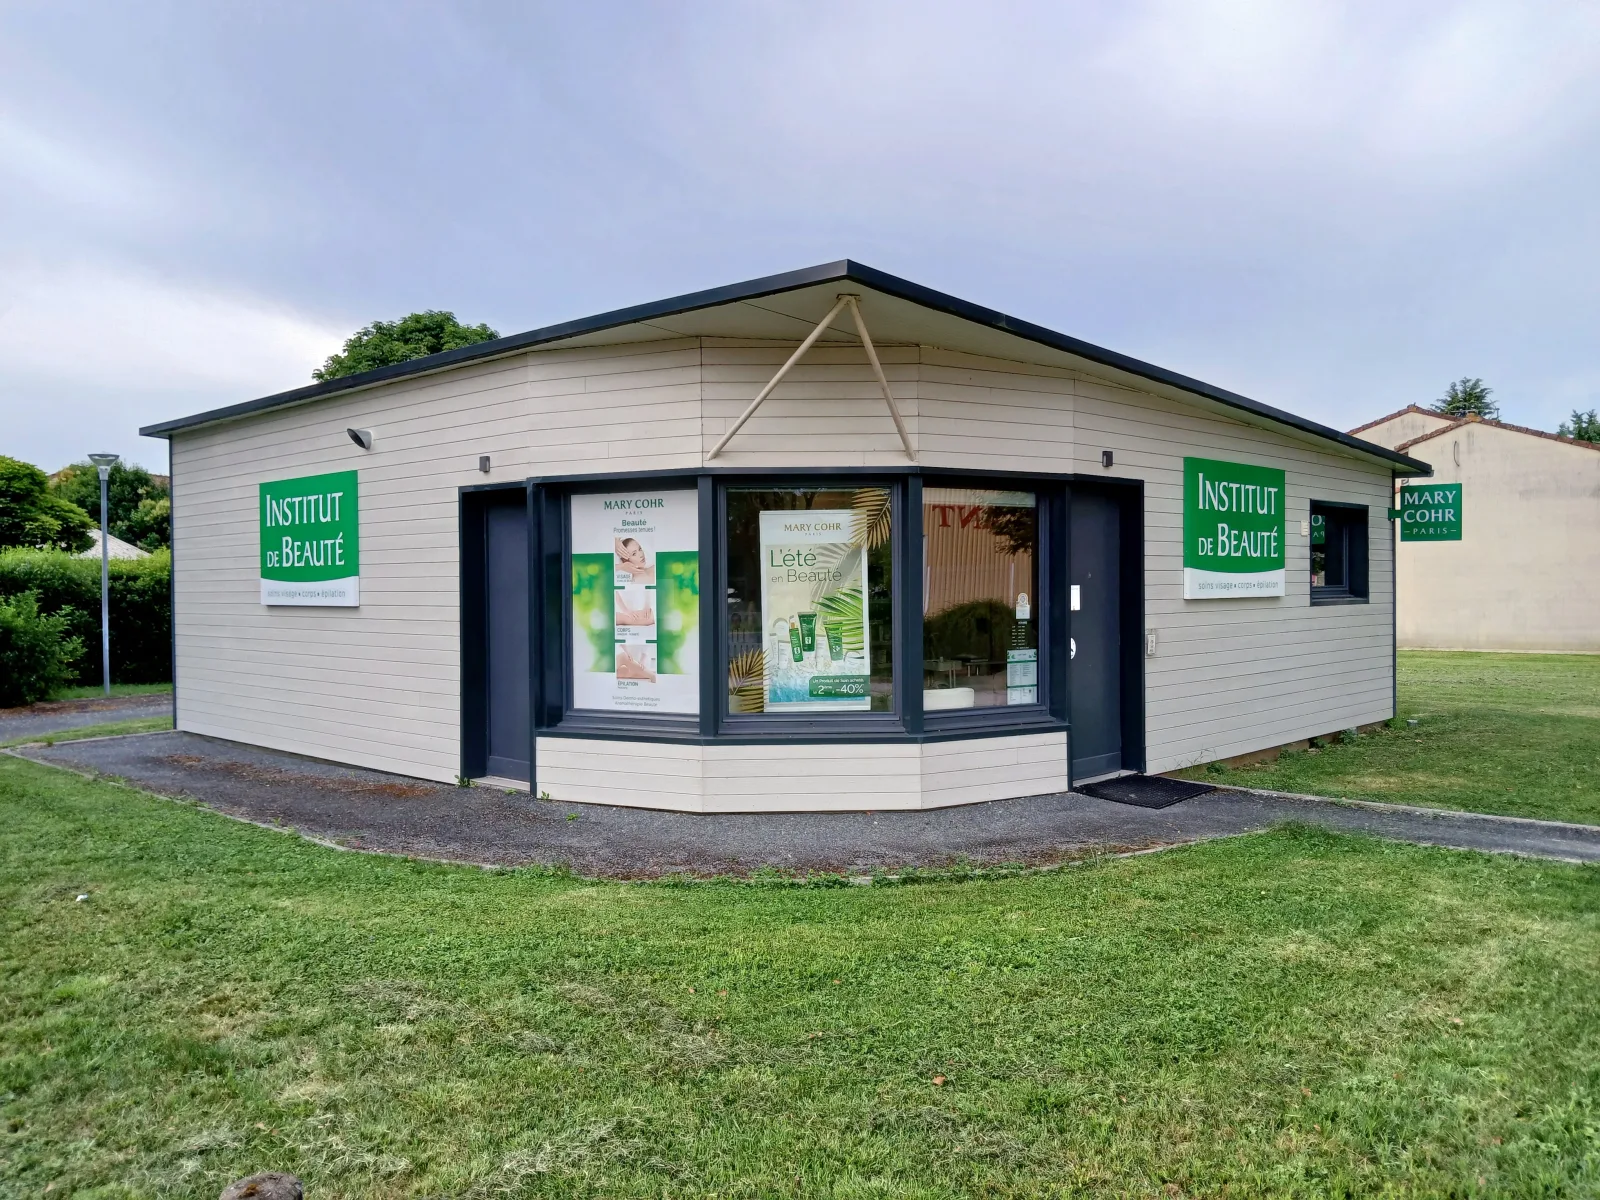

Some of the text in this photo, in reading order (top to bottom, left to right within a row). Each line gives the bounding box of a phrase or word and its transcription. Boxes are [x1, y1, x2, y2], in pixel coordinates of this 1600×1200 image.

[1404, 490, 1456, 505] MARY
[604, 498, 664, 510] MARY COHR
[1403, 509, 1456, 523] COHR
[621, 519, 647, 527] Beauté
[784, 522, 842, 531] MARY COHR
[1412, 527, 1448, 535] PARIS
[1198, 537, 1214, 556] DE
[267, 551, 280, 567] DE
[770, 548, 817, 568] L'été
[787, 567, 842, 583] Beauté
[1198, 580, 1279, 591] soins visage corps épilation
[281, 590, 298, 598] visage
[302, 590, 317, 598] corps
[321, 589, 346, 598] épilation
[836, 684, 864, 694] -40%
